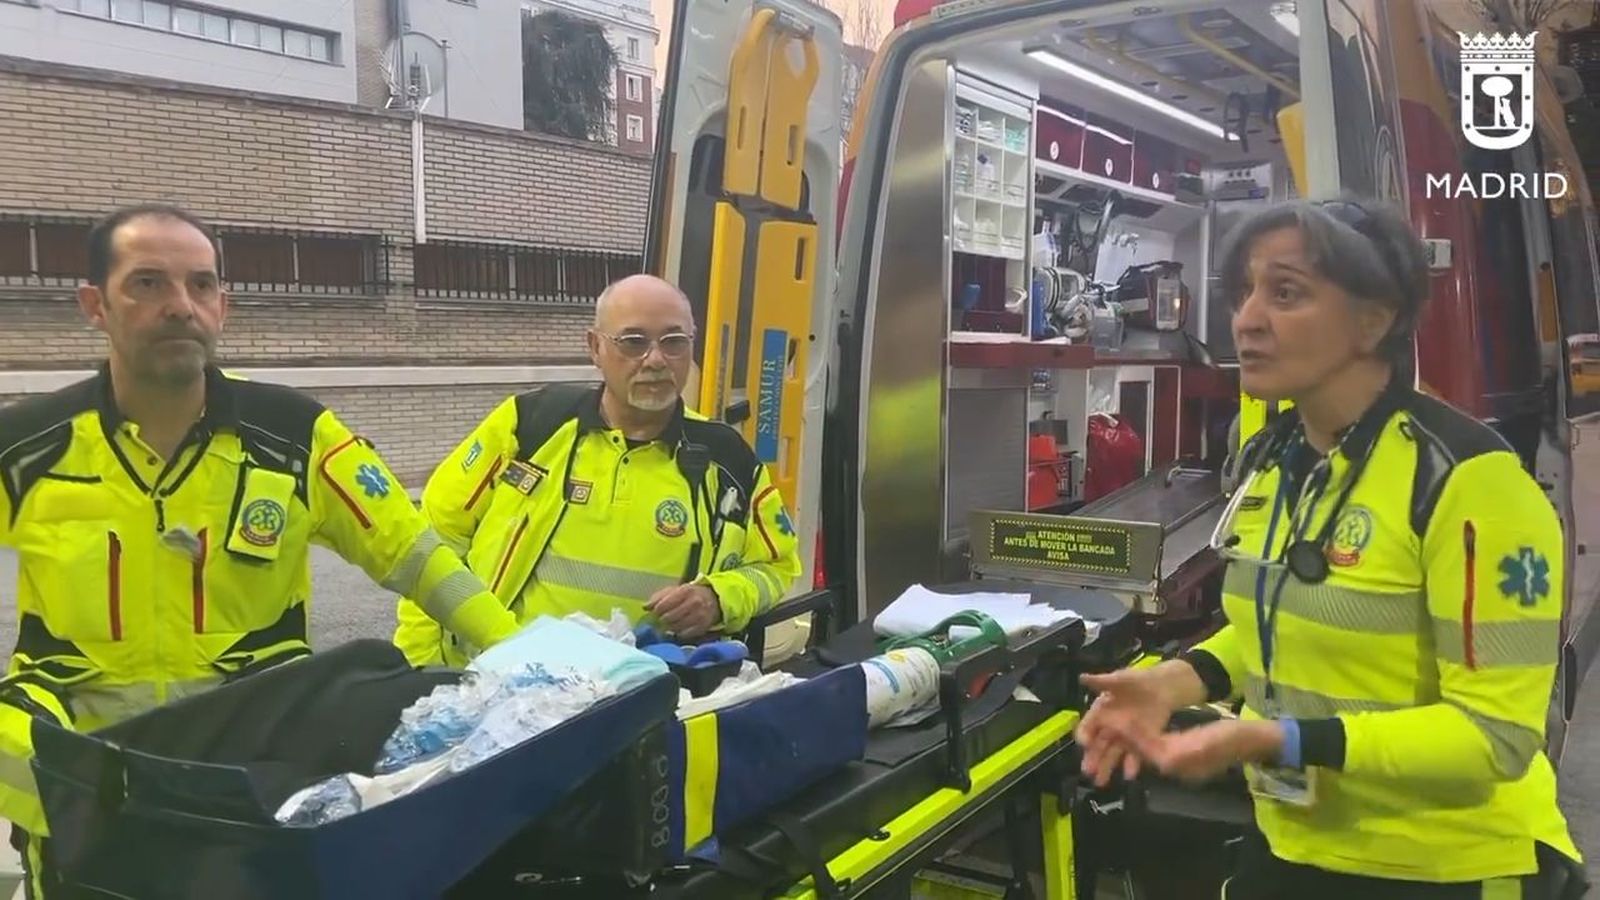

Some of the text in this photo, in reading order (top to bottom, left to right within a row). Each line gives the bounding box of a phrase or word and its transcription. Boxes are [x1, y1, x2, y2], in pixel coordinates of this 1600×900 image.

[758, 359, 776, 434] SAMUR
[1003, 537, 1116, 555] ANTES DE MOVER LA BANCADA
[1047, 551, 1070, 561] AVISA
